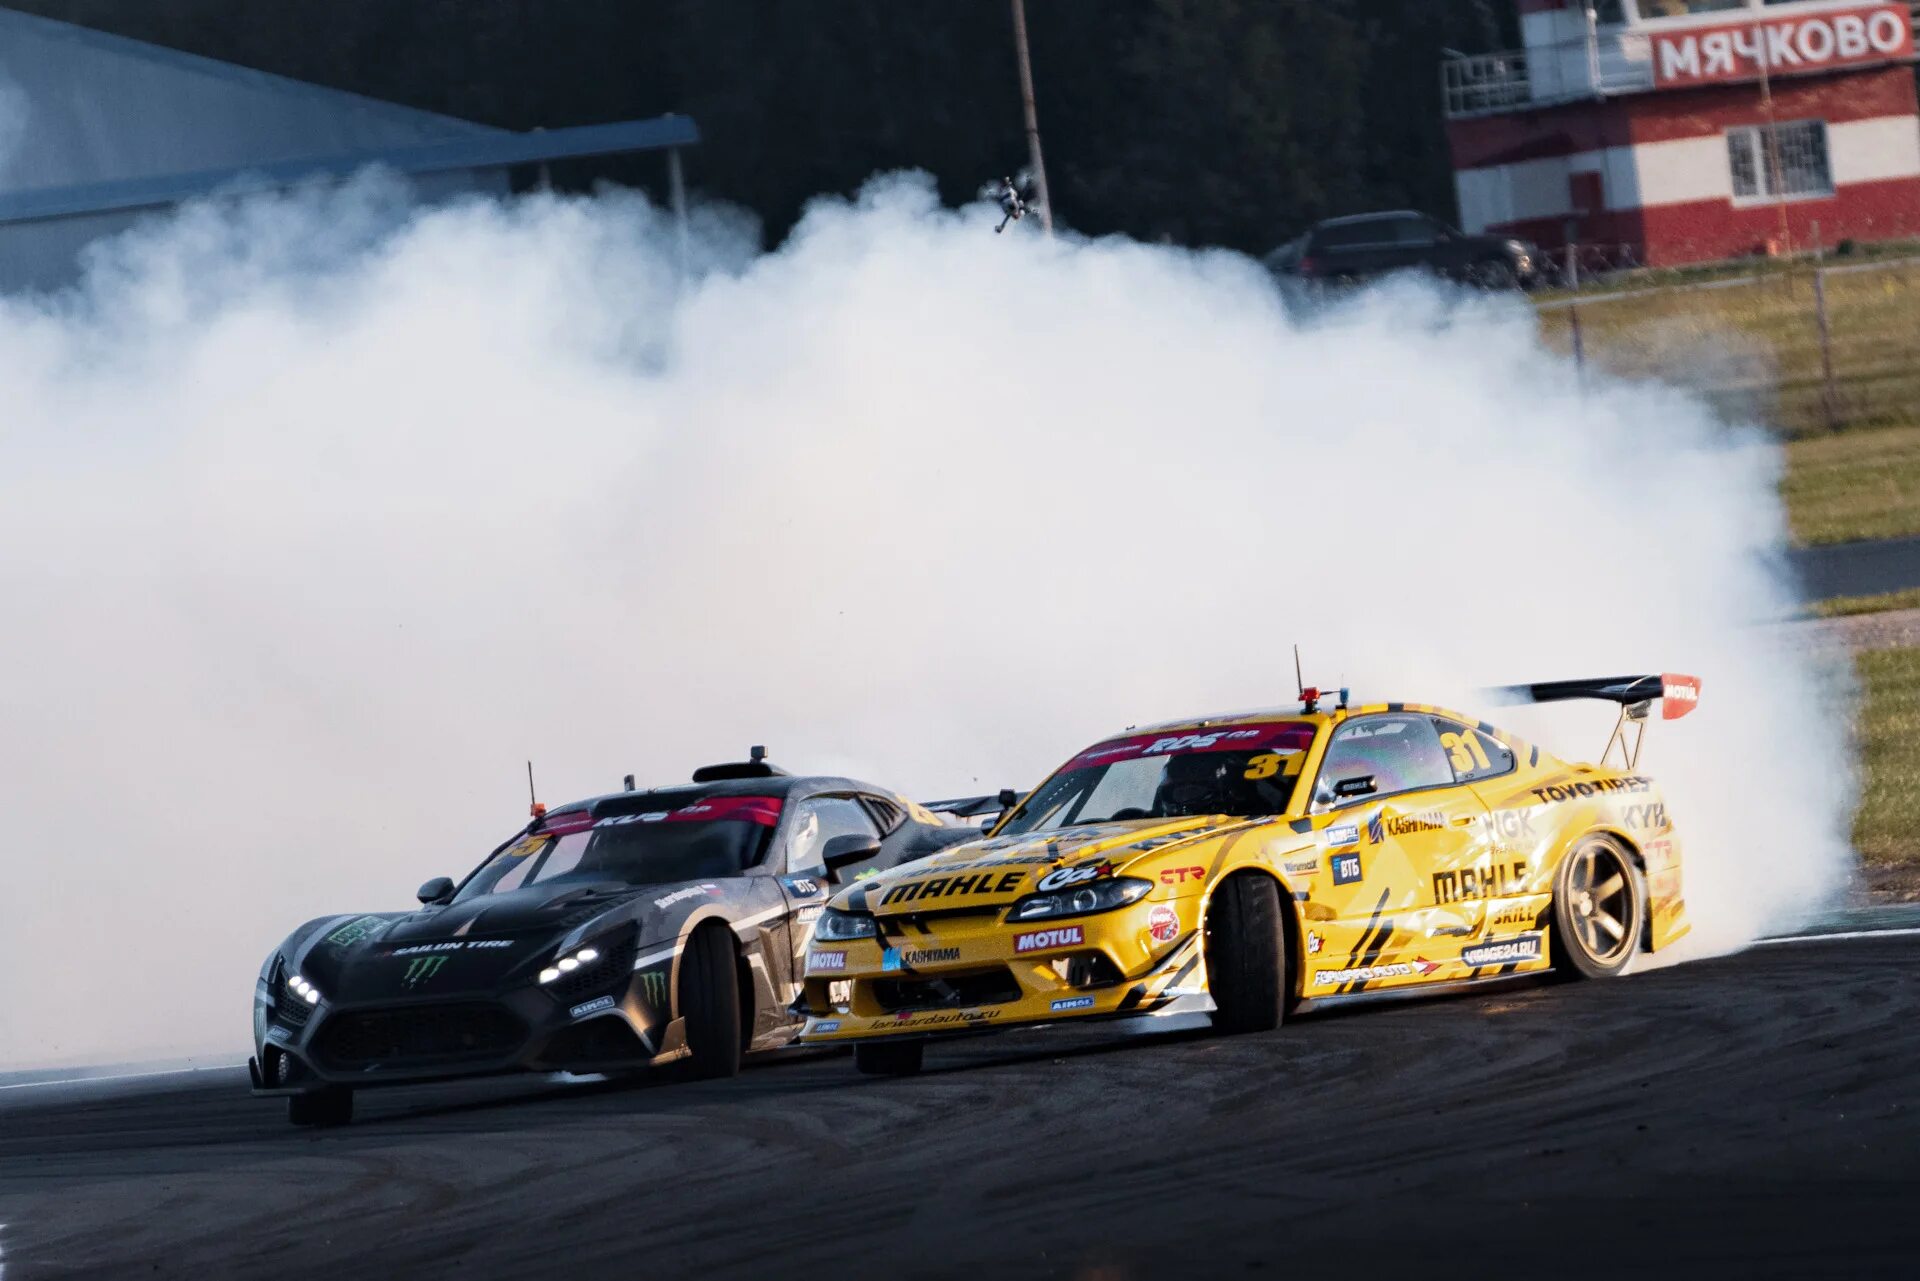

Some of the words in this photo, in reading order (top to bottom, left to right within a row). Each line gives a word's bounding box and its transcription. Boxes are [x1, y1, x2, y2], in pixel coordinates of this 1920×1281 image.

[1658, 10, 1905, 81] МЯЧКОВО
[1664, 682, 1697, 700] MOTUL
[1142, 731, 1229, 753] RDS
[1440, 729, 1491, 773] 31
[1244, 752, 1307, 780] 31
[1483, 807, 1535, 838] NGK
[1160, 866, 1206, 884] CTR
[1432, 861, 1526, 905] MAHLE
[880, 871, 1028, 905] MAHLE
[392, 941, 463, 956] SAILUN
[466, 940, 514, 949] TIRE
[1017, 928, 1082, 950] MOTUL
[810, 952, 844, 968] MOTUL
[905, 948, 960, 965] KASHIYAMA
[868, 1010, 1001, 1030] forwardauto.ru
